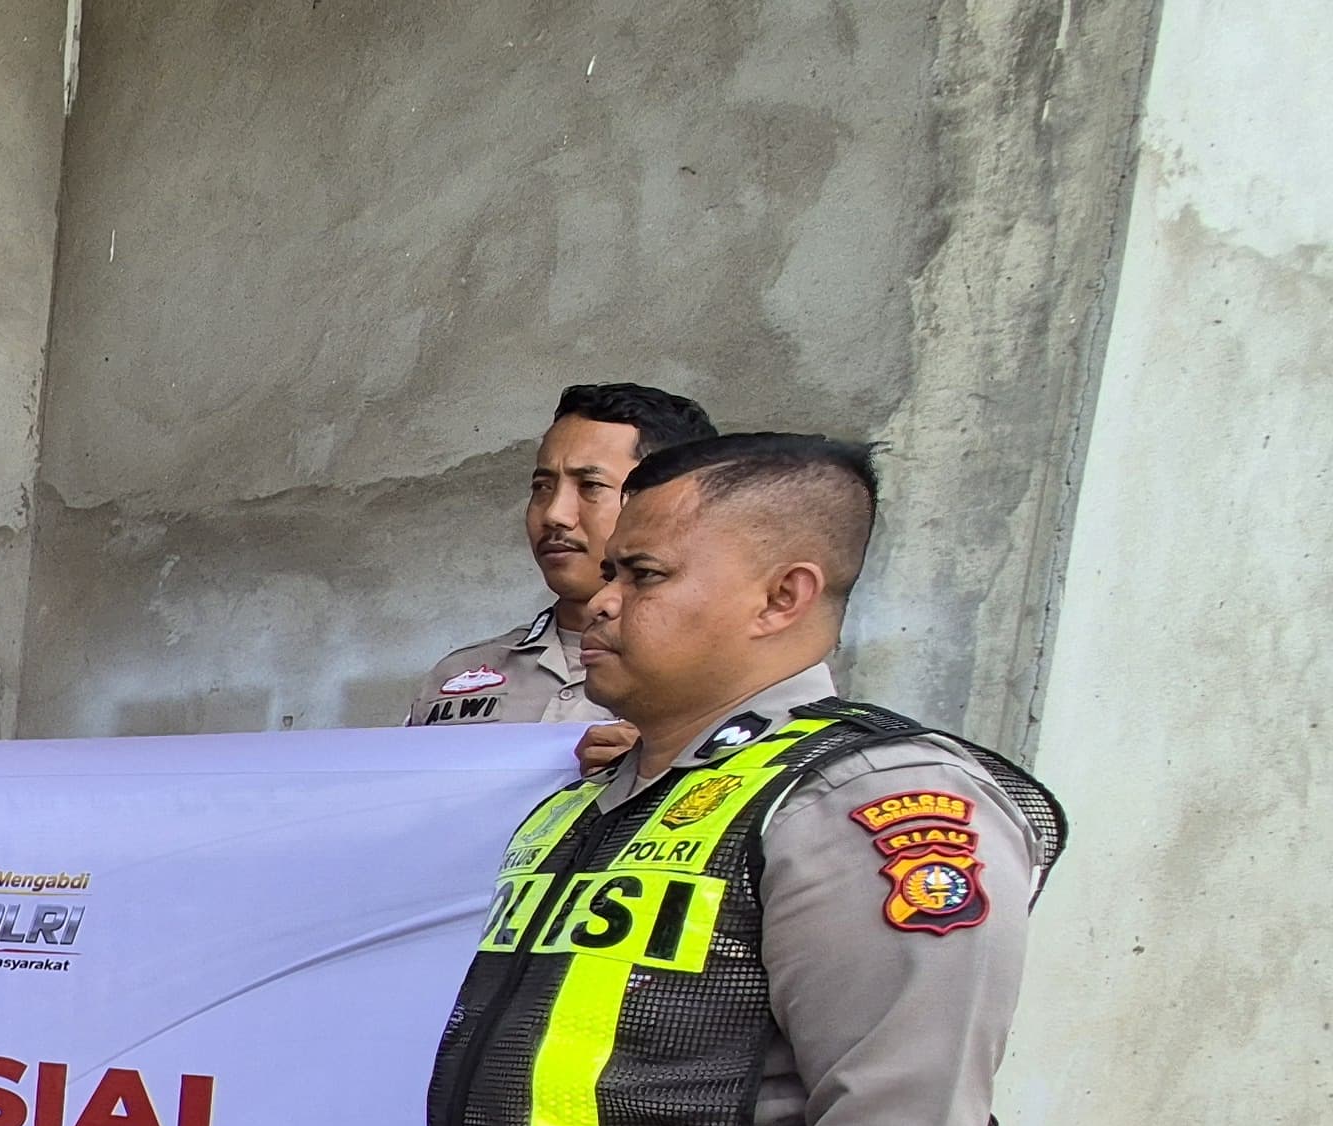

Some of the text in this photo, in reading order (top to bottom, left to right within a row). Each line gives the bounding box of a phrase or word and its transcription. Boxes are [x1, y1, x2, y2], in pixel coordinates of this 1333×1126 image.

[863, 794, 965, 821] POLRES
[889, 829, 969, 848] RIAU
[620, 841, 702, 862] POLRI
